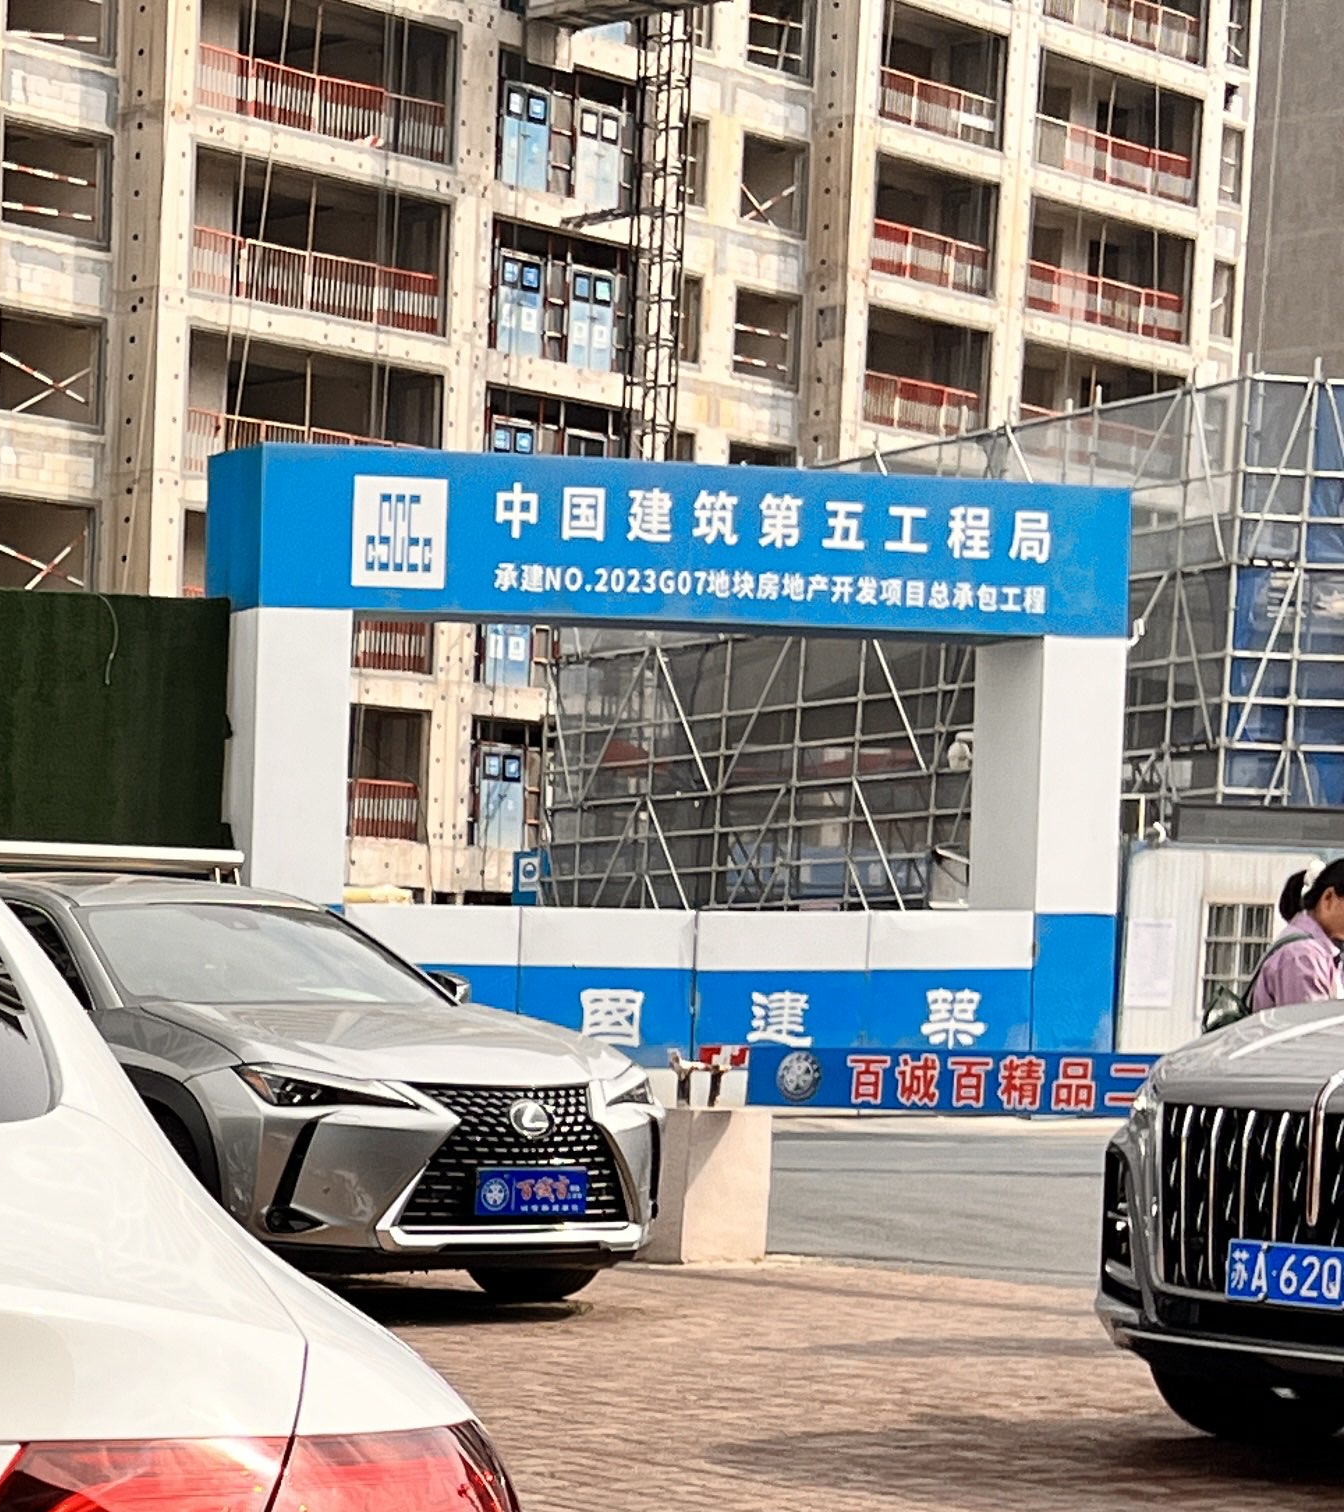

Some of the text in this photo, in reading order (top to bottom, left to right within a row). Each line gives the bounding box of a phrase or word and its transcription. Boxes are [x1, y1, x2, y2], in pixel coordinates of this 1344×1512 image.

[494, 481, 1053, 564] 中国建筑第五工程局
[493, 562, 1048, 614] 承建NO.2023G07地块房地产开发项目总承包工程
[847, 1053, 1150, 1109] 百诚百精品二
